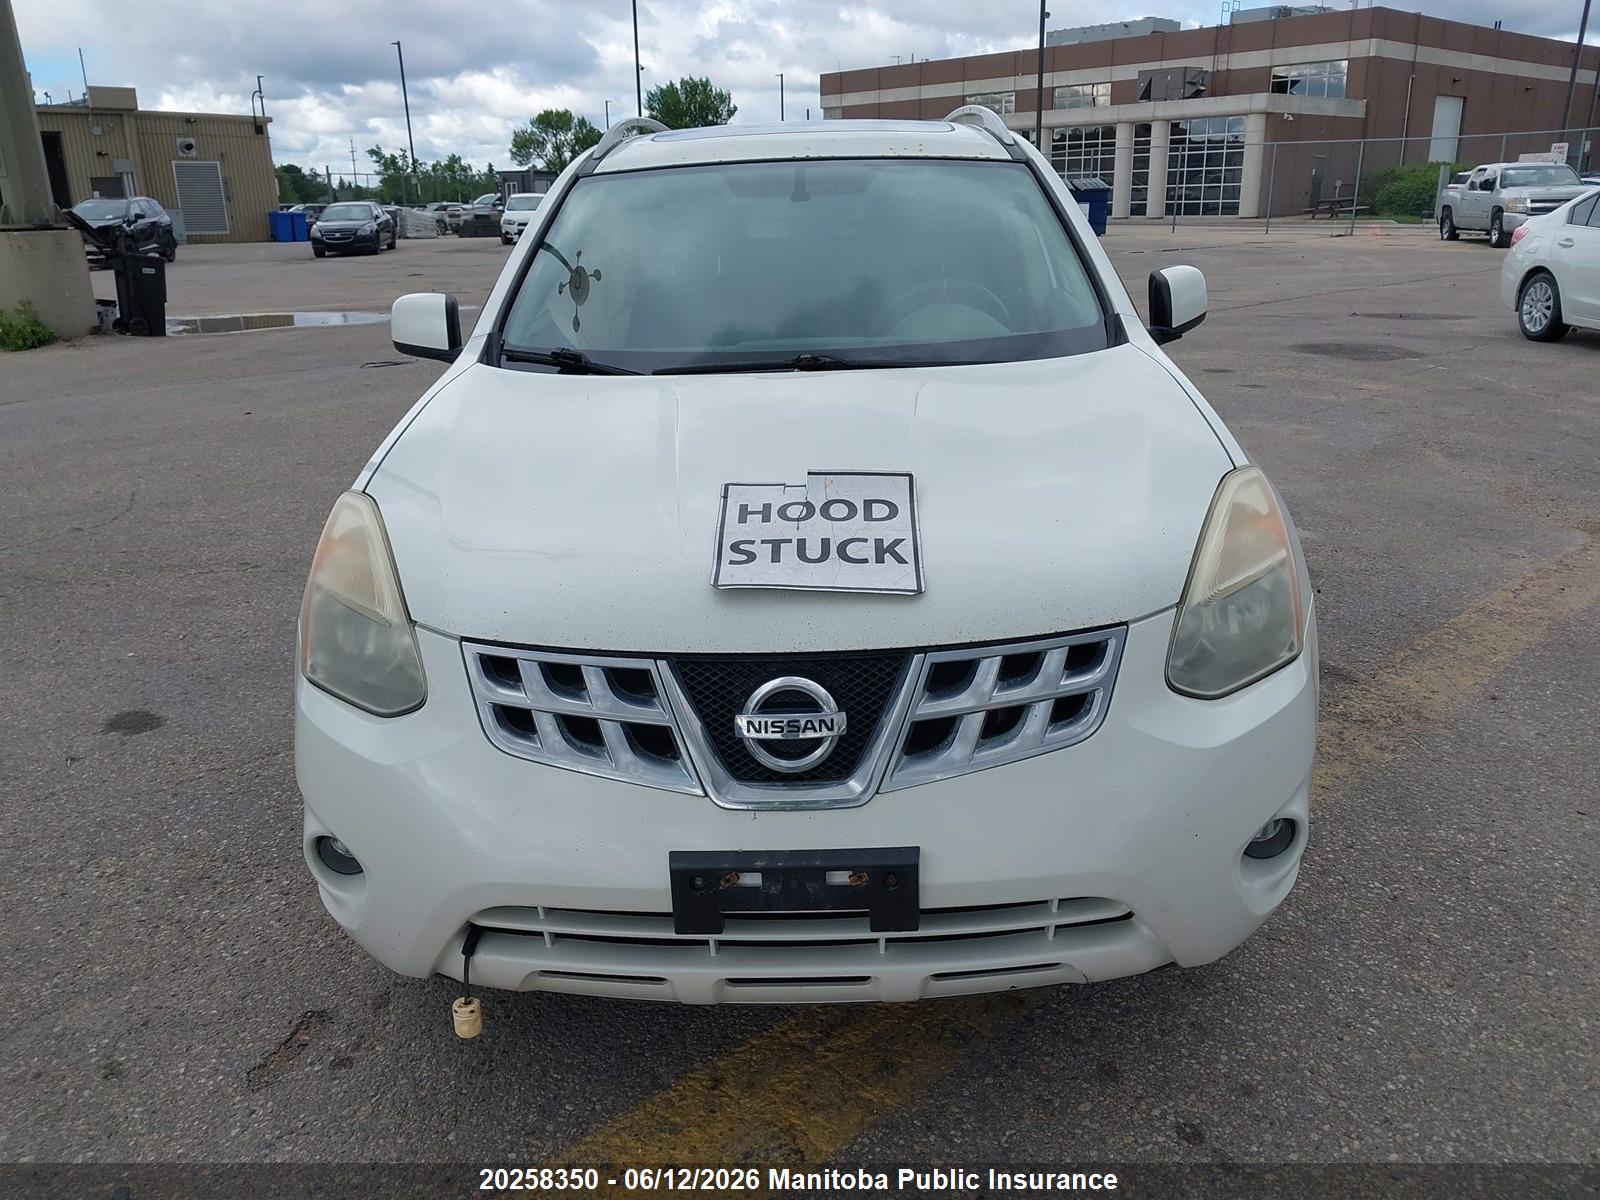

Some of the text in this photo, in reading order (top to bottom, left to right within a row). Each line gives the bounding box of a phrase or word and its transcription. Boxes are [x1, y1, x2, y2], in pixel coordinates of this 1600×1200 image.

[737, 498, 899, 524] HOOD
[728, 537, 909, 565] STUCK
[746, 718, 834, 734] NISSAN
